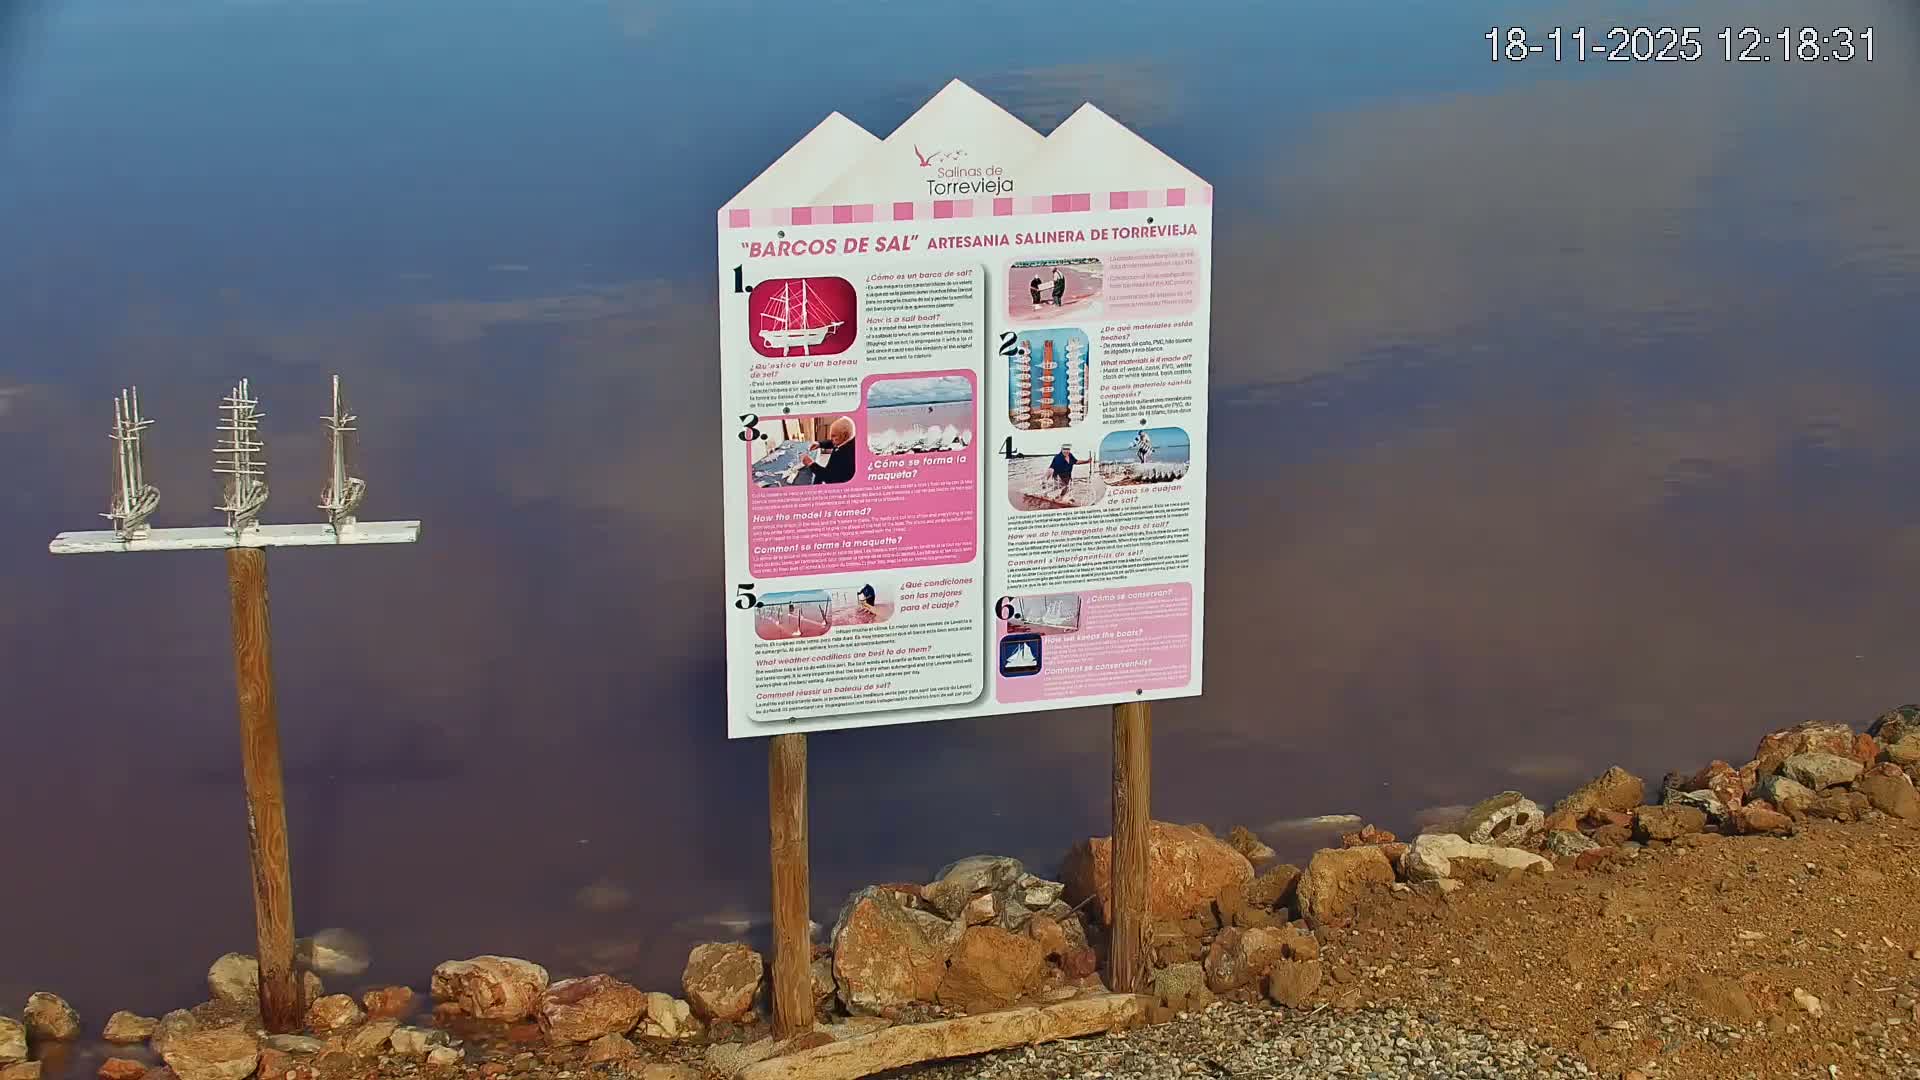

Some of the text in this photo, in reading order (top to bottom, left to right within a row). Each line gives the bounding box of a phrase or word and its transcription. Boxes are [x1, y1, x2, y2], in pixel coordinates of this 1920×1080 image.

[937, 164, 1002, 178] Salinas de
[926, 177, 1014, 197] Torrevieja
[843, 236, 871, 255] DE
[927, 232, 1010, 250] ARTESANIA
[1014, 229, 1086, 246] SALINERA
[1090, 228, 1109, 242] DE
[1111, 223, 1198, 240] TORREVIEJA
[733, 264, 754, 294] 1.
[907, 272, 918, 280] un
[919, 271, 943, 279] barco
[956, 269, 973, 277] sal?
[866, 317, 884, 325] How
[885, 316, 892, 324] is
[917, 313, 941, 322] boat?
[1133, 322, 1172, 331] materiales
[999, 331, 1026, 357] 2.
[1100, 333, 1131, 342] hechos?
[827, 358, 858, 367] bateau
[1100, 359, 1118, 368] What
[1118, 357, 1149, 366] materials
[1156, 355, 1161, 363] it
[1161, 355, 1182, 363] made
[750, 371, 761, 379] de
[738, 413, 768, 442] 3.
[867, 455, 968, 471] ¿Cómo se forma la
[867, 469, 918, 481] maqueta?
[1152, 484, 1182, 494] cuajan
[752, 514, 774, 523] How
[775, 512, 791, 521] the
[792, 510, 823, 520] model
[834, 507, 872, 518] formed?
[1060, 526, 1104, 536] impregnate
[1106, 525, 1118, 533] the
[753, 536, 903, 554] Comment se forme la maquette?
[1007, 557, 1047, 567] Comment
[900, 576, 973, 591] ¿Qué condiciones
[900, 589, 962, 601] son las mejores
[900, 600, 960, 613] para el cuaje?
[1101, 630, 1115, 639] the
[756, 645, 932, 667] What weather conditions are best to do them?
[1045, 666, 1082, 675] Comment
[756, 690, 795, 700] Comment
[822, 686, 833, 694] un
[834, 684, 863, 694] bateau
[864, 683, 875, 691] de
